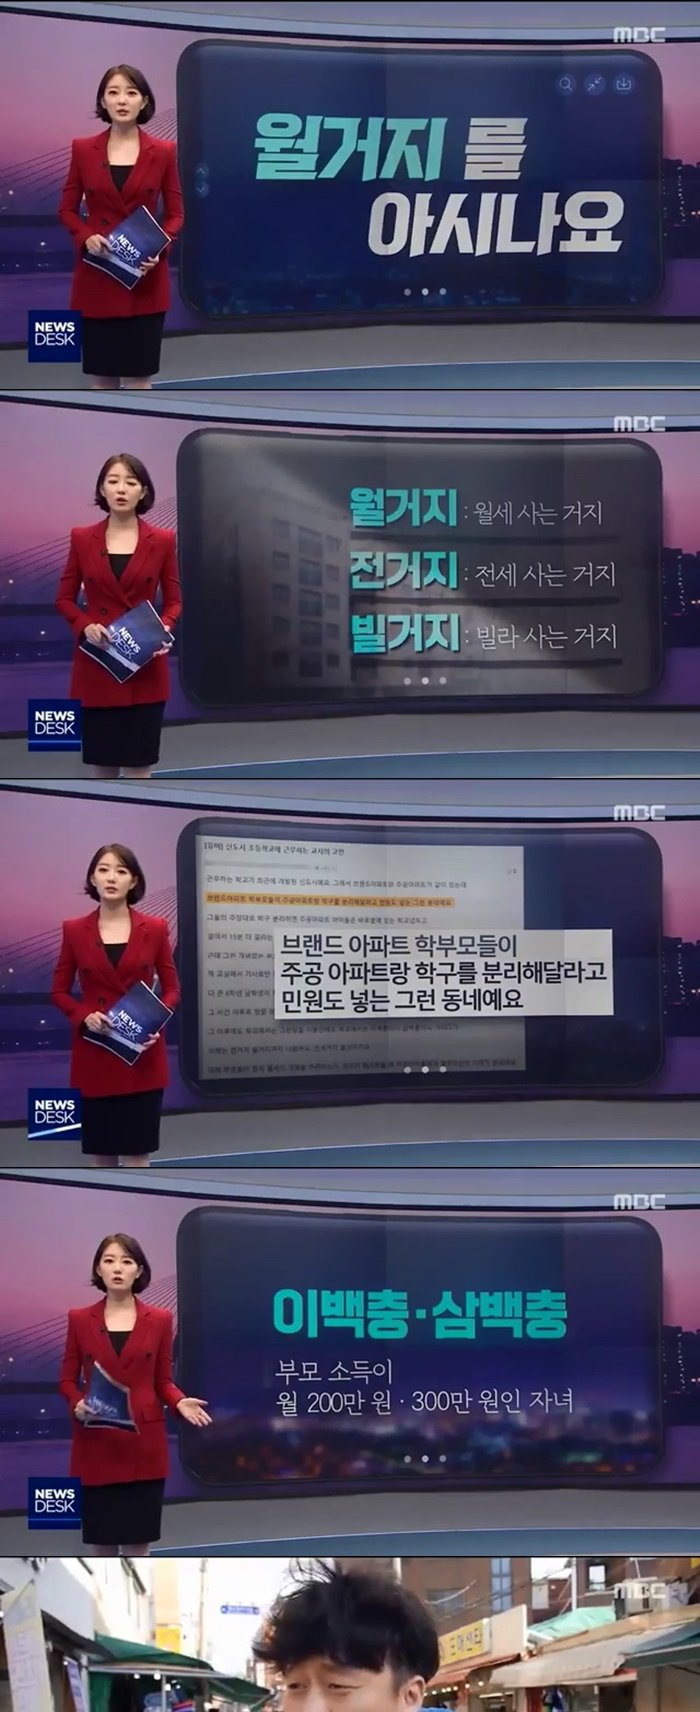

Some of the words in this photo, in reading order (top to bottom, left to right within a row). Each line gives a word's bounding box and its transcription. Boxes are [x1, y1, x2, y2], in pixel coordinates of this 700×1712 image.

[255, 113, 448, 182] 월거지
[463, 117, 529, 181] 를
[367, 190, 626, 258] 아시나요
[110, 239, 137, 265] DESK
[117, 234, 141, 258] NEWS
[350, 487, 458, 527] 월거지
[473, 501, 513, 526] 월세
[517, 502, 557, 525] 사는
[562, 501, 603, 526] 거지
[350, 550, 458, 590] 전거지
[474, 562, 516, 588] 전세
[523, 562, 566, 588] 사는
[573, 562, 617, 588] 거지
[351, 613, 460, 654] 빌거지
[476, 625, 518, 651] 빌라
[525, 625, 568, 650] 사는
[575, 624, 618, 650] 거지
[281, 934, 344, 957] 브랜드
[348, 934, 409, 957] 아파트
[415, 934, 518, 957] 학부모들이
[280, 961, 324, 985] 주공
[328, 961, 411, 985] 아파트랑
[415, 961, 477, 985] 학구를
[482, 961, 608, 985] 분리해달라고
[281, 988, 346, 1012] 민원도
[350, 988, 390, 1012] 넣는
[394, 988, 436, 1012] 그런
[441, 988, 524, 1012] 동네예요
[275, 1359, 322, 1384] 부모
[329, 1359, 394, 1384] 소득이
[276, 1390, 299, 1415] 월
[306, 1390, 365, 1415] 200만
[371, 1390, 393, 1415] 원
[411, 1390, 472, 1415] 300만
[479, 1390, 521, 1415] 원인
[528, 1390, 574, 1415] 자녀
